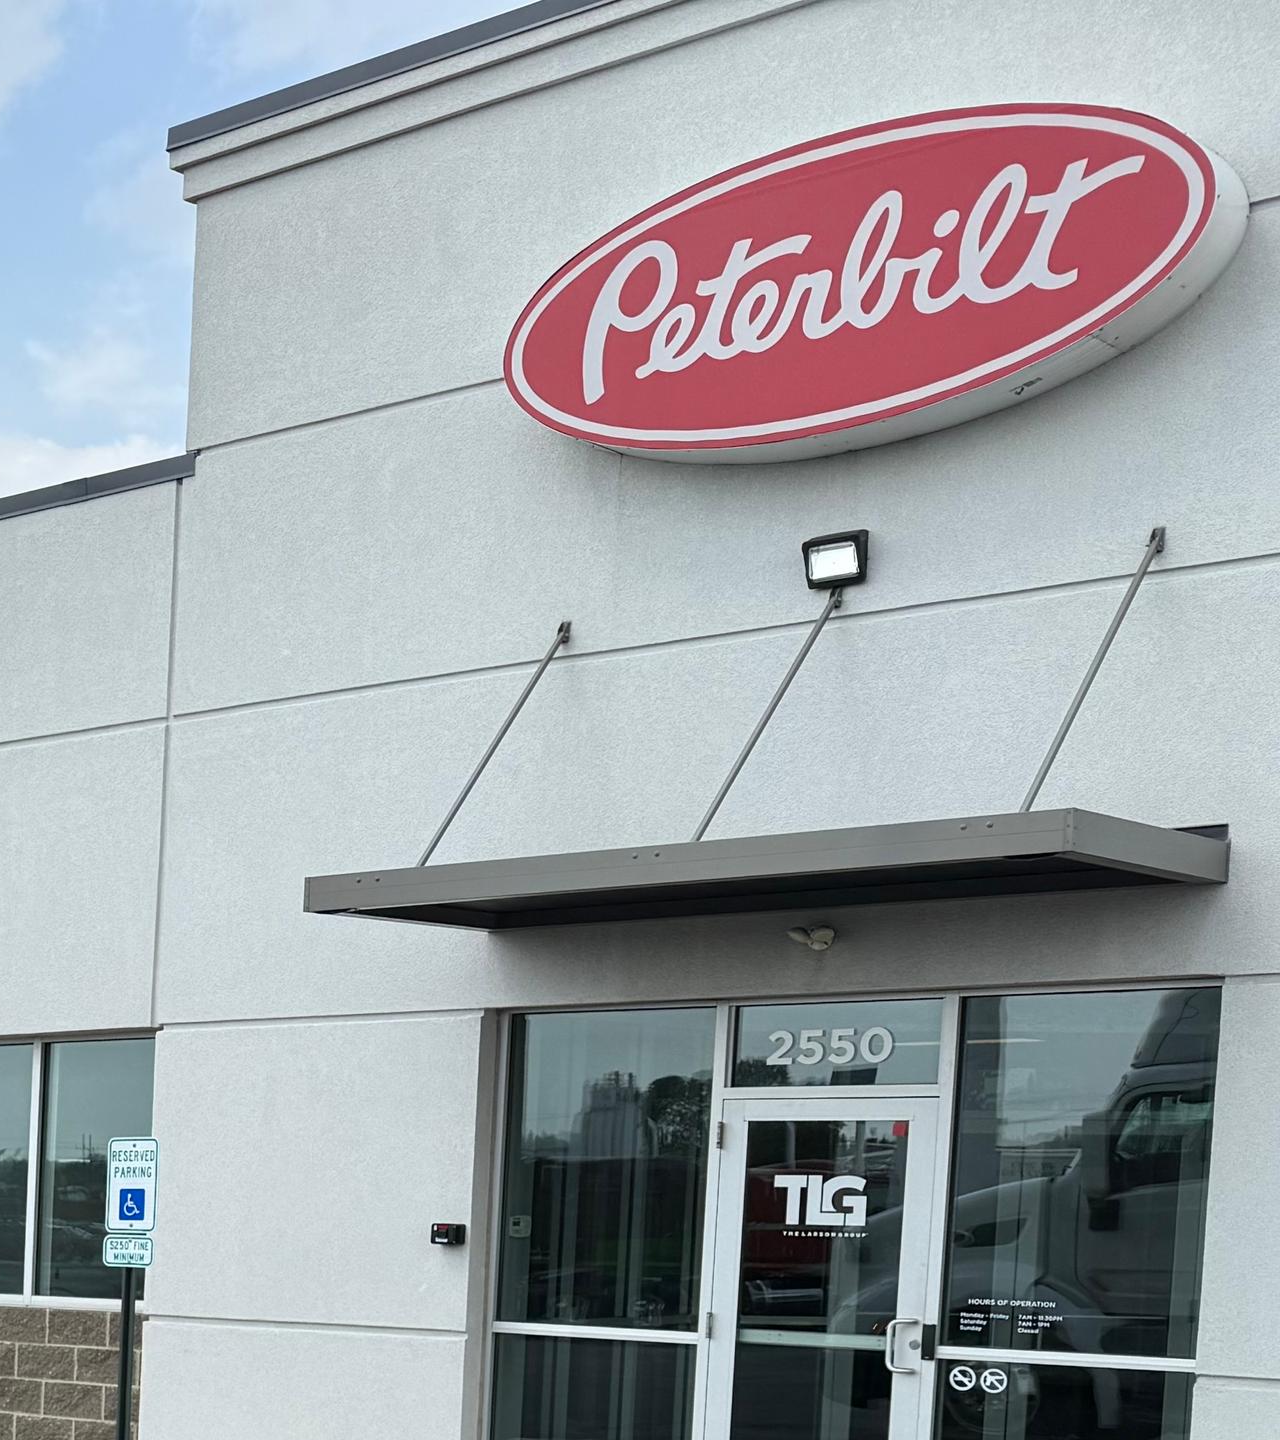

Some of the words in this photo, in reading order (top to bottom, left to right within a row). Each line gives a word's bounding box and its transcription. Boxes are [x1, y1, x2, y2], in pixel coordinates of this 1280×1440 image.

[581, 154, 1146, 405] Peterbilt
[766, 1026, 894, 1066] 2550
[112, 1150, 155, 1162] RESERVED
[114, 1166, 152, 1178] PARKING
[774, 1174, 867, 1226] TLG
[133, 1241, 149, 1251] FINE
[113, 1252, 145, 1262] MINIMUM
[1010, 1300, 1056, 1308] OPERATION
[960, 1311, 984, 1319] Monday
[990, 1312, 1009, 1320] Friday
[960, 1318, 987, 1326] Saturday
